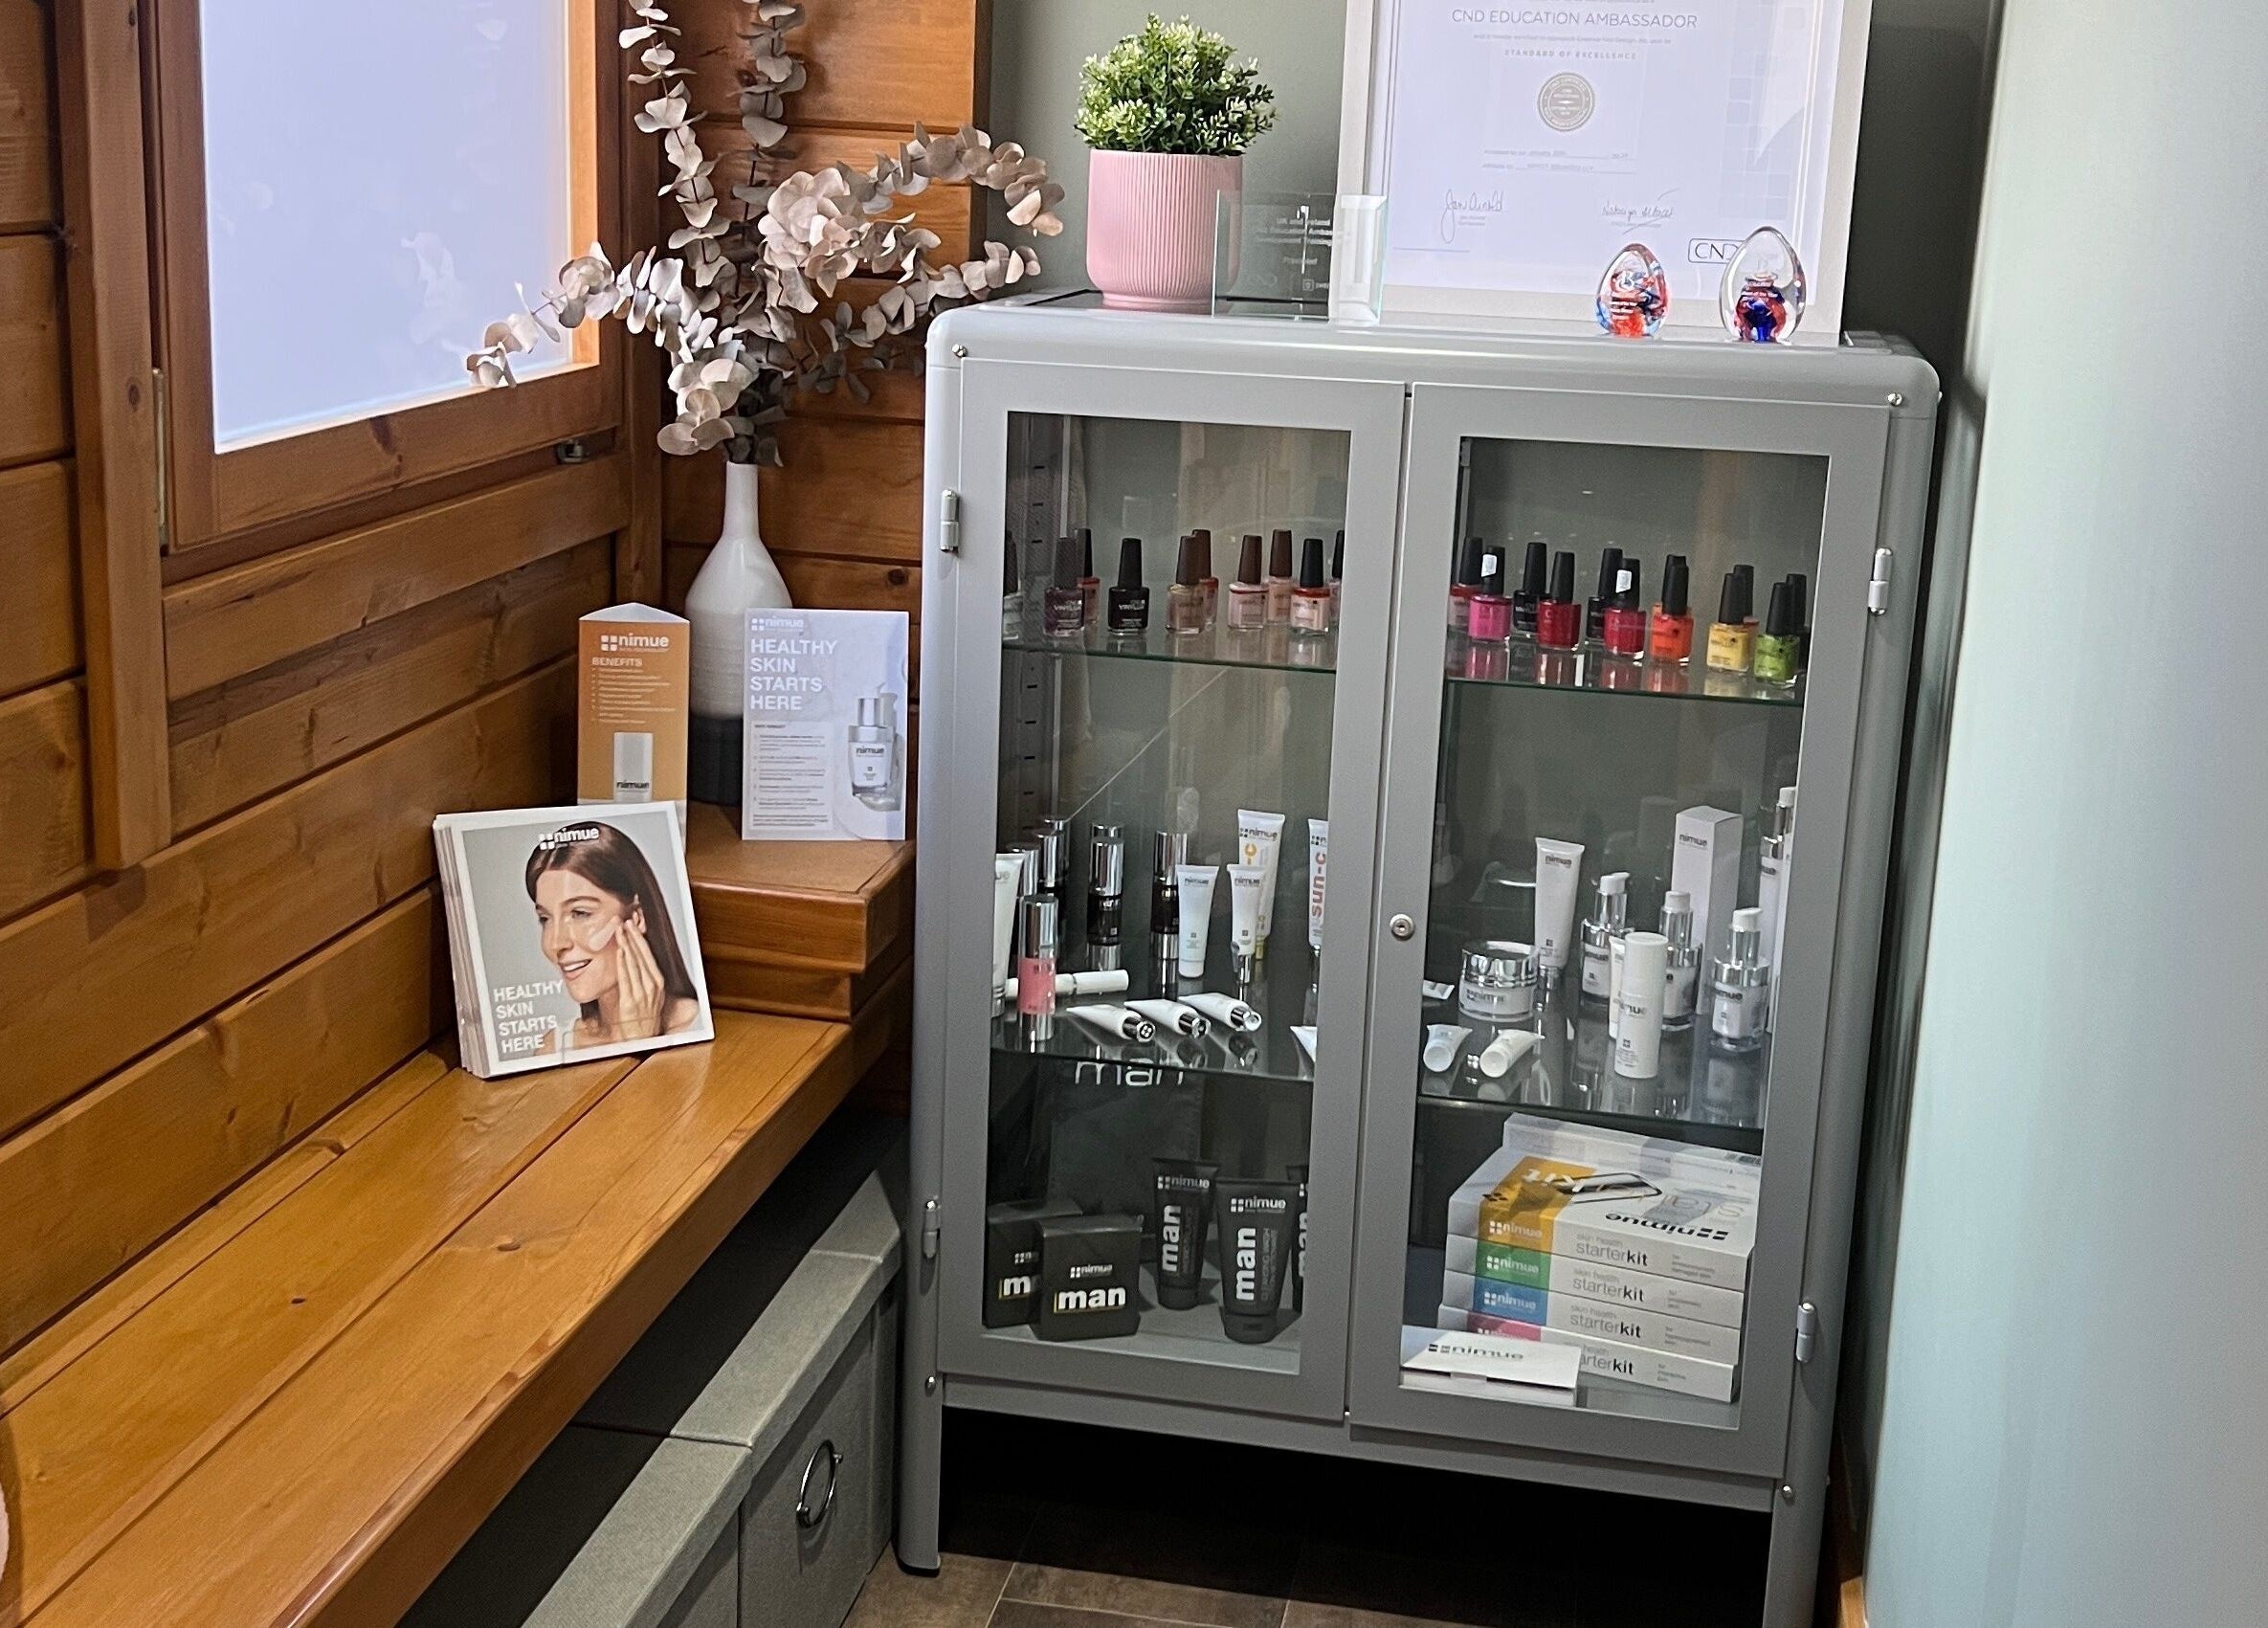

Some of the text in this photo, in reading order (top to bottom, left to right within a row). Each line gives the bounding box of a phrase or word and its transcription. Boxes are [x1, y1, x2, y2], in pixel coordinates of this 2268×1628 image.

[1452, 10, 1698, 29] CND EDUCATION AMBASSADOR
[766, 615, 804, 628] nimue
[617, 632, 669, 648] nimue
[750, 638, 838, 656] HEALTHY
[591, 657, 643, 667] BENEFITS
[749, 657, 797, 674] SKIN
[749, 676, 824, 693] STARTS
[750, 694, 803, 711] HERE
[554, 828, 600, 843] nimue
[1248, 827, 1279, 840] nimue
[493, 979, 564, 1003] HEALTHY
[496, 1000, 534, 1019] SKIN
[499, 1015, 558, 1037] STARTS
[501, 1033, 545, 1054] HERE
[1171, 1174, 1211, 1189] nimue
[1244, 1195, 1287, 1210] nimue
[1503, 1220, 1544, 1238] nimue
[1606, 1213, 1696, 1236] nimue
[1162, 1205, 1182, 1272] man
[1575, 1241, 1648, 1267] starterkit
[1080, 1263, 1113, 1275] nimue
[1235, 1227, 1256, 1301] man
[1500, 1258, 1540, 1275] nimue
[1057, 1287, 1126, 1310] man
[1572, 1278, 1644, 1303] starterkit
[1497, 1292, 1537, 1310] nimue
[1569, 1314, 1641, 1339] starterkit
[1452, 1345, 1523, 1360] nimue
[1580, 1353, 1634, 1376] arterkit
